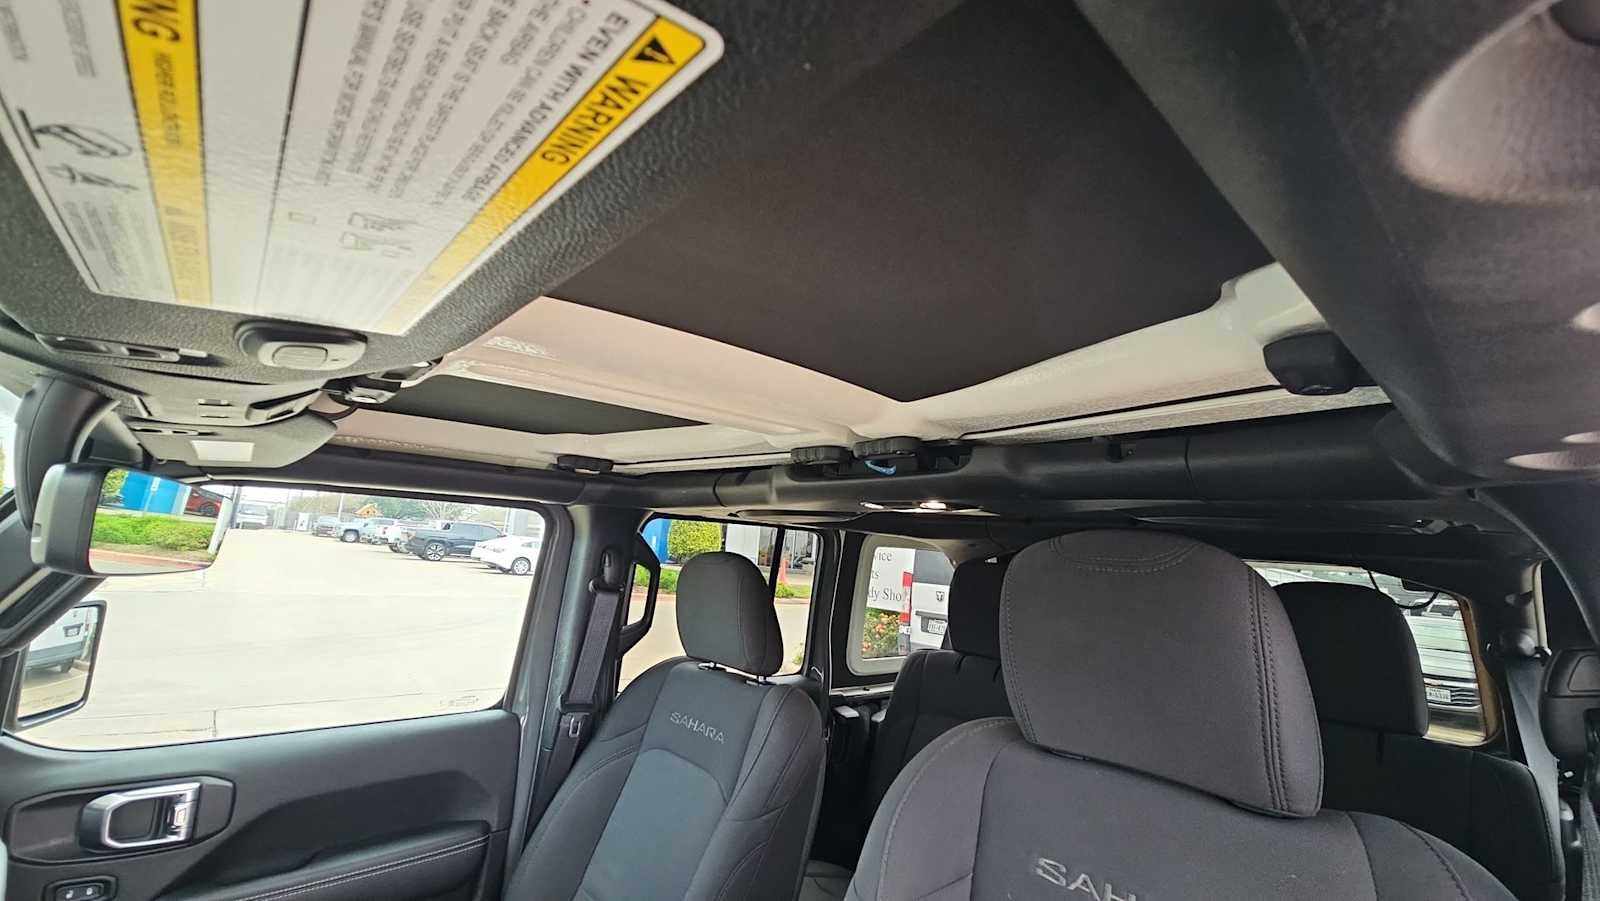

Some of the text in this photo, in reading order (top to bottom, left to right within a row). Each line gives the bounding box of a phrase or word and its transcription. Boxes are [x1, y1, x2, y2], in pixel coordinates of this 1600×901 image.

[577, 11, 630, 63] EVEN
[543, 63, 585, 103] WITH
[493, 98, 553, 164] ADVANCED
[541, 74, 649, 166] WARNING
[669, 711, 725, 745] SAHARA
